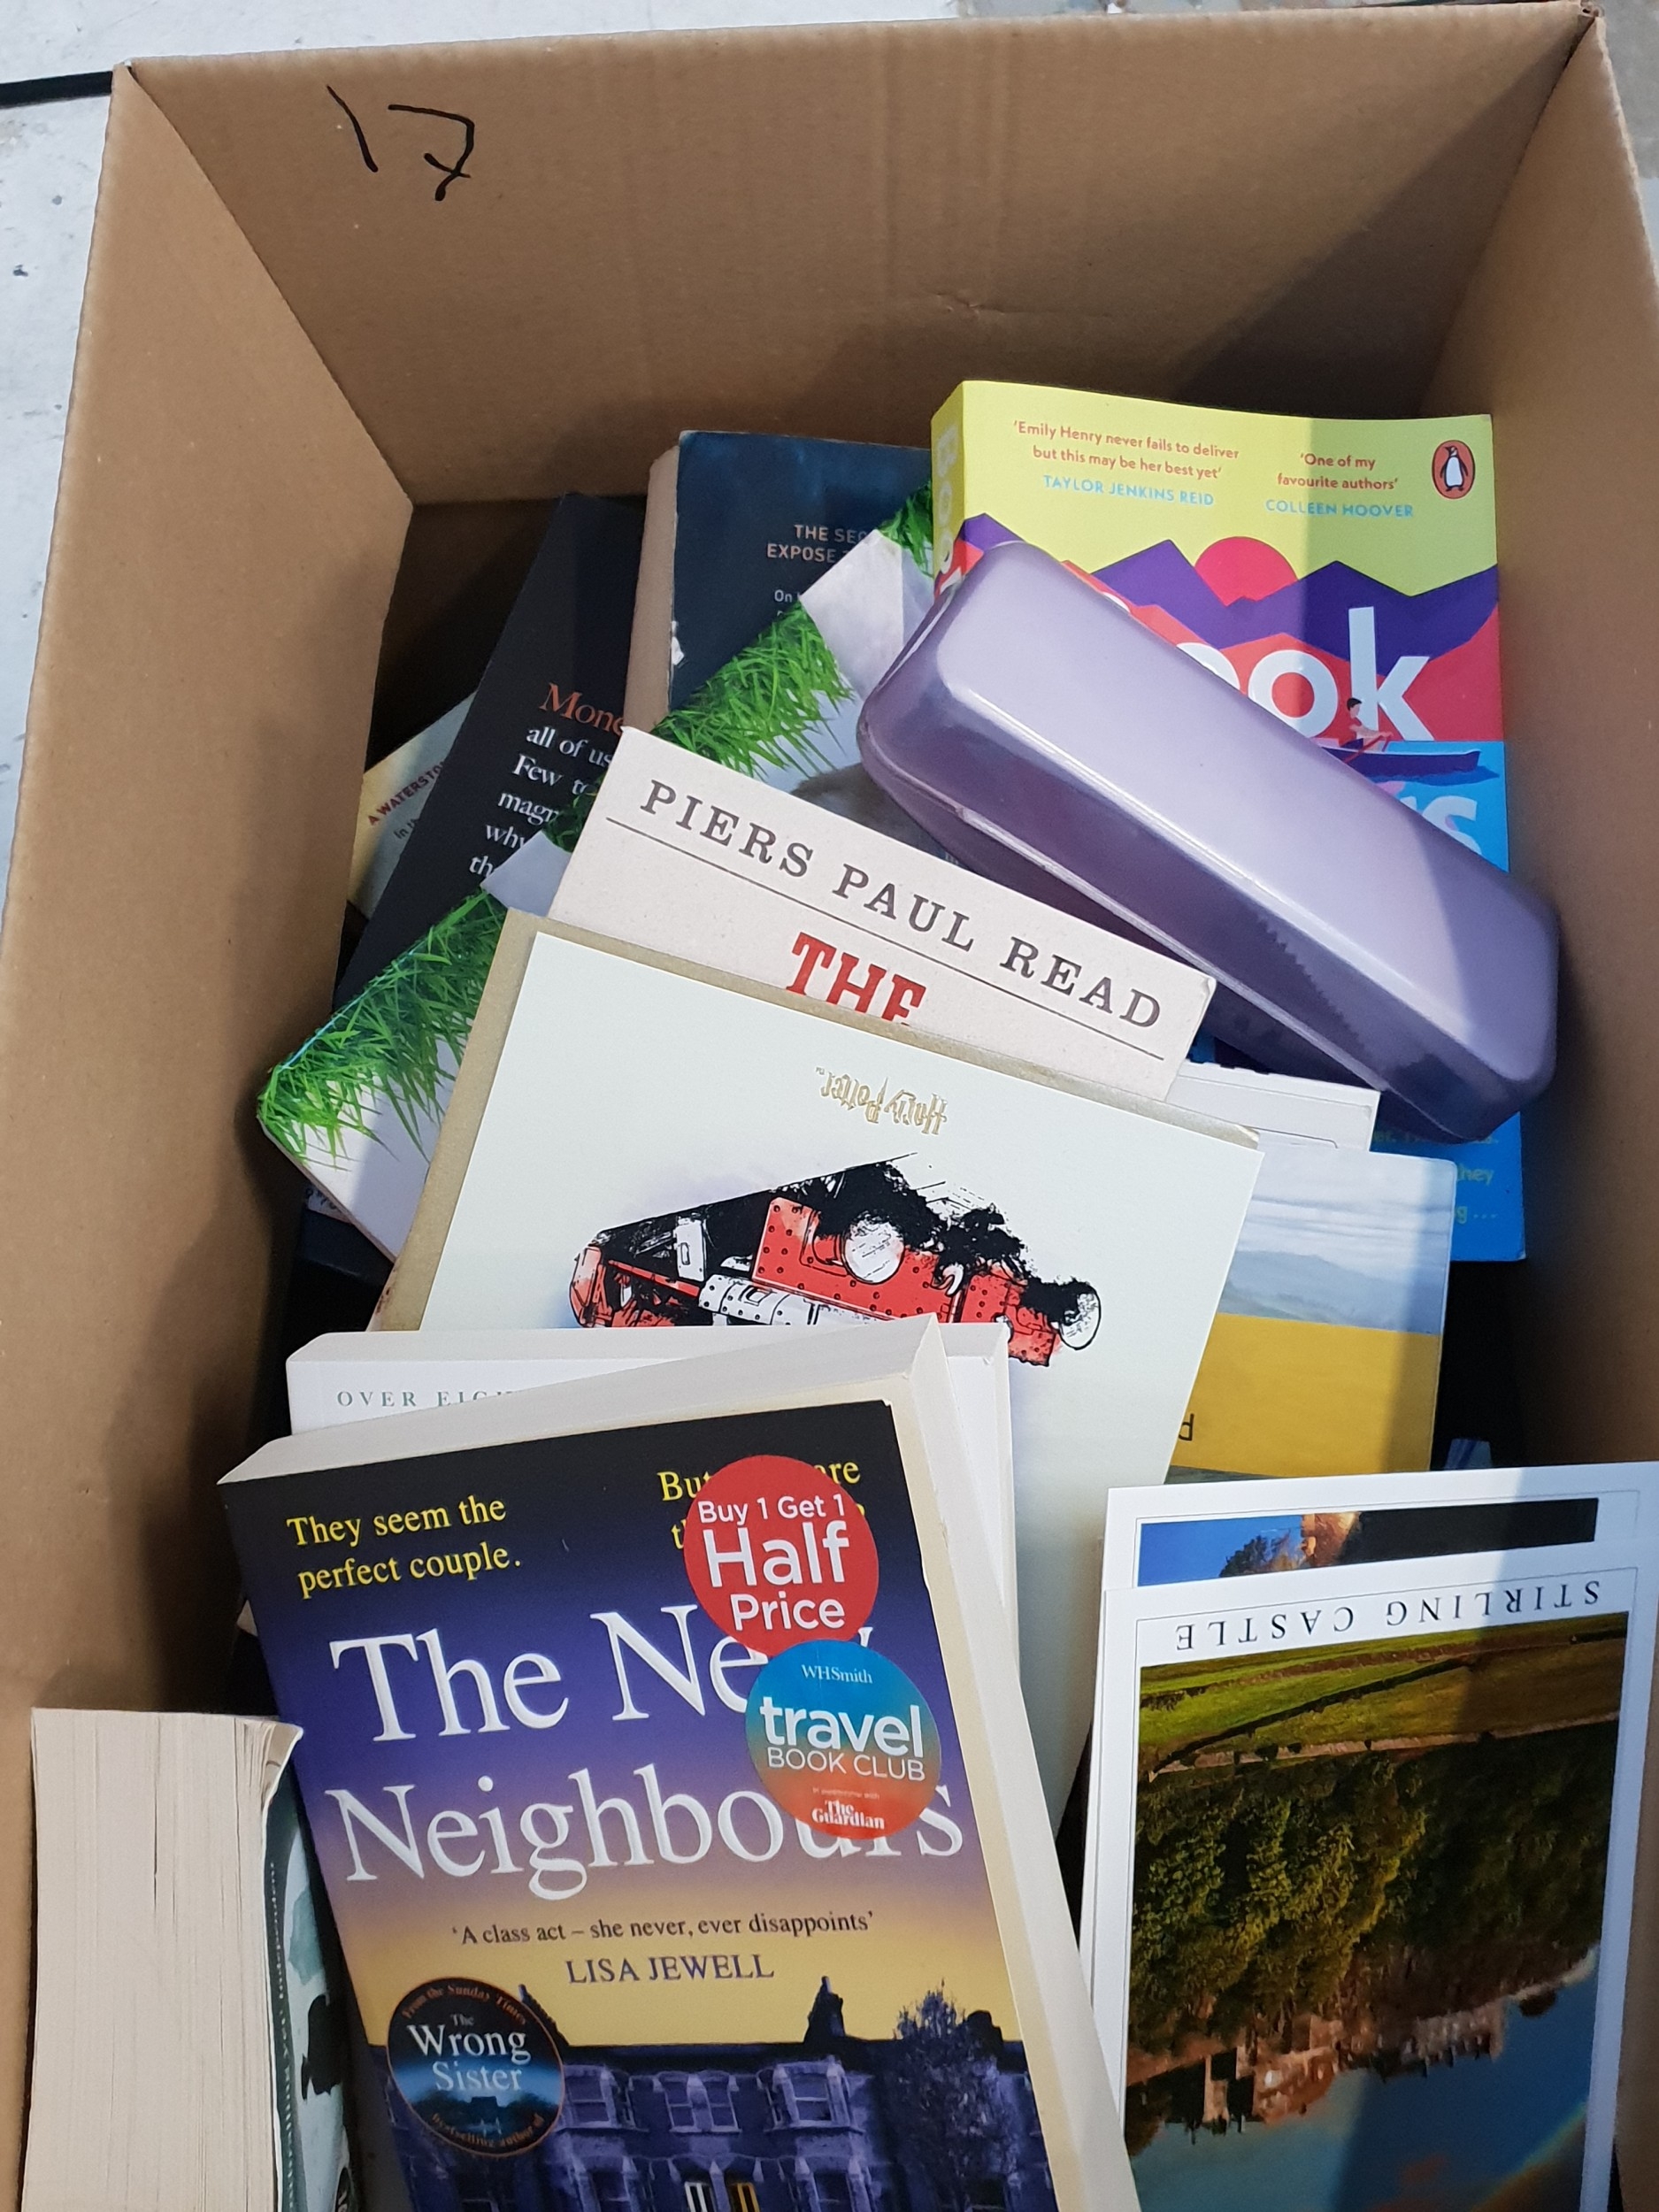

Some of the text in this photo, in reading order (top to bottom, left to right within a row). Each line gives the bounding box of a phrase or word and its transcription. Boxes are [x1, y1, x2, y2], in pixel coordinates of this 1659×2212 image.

[326, 84, 476, 202] 17
[1060, 426, 1102, 445] Henry
[1106, 434, 1143, 448] never
[1147, 436, 1172, 452] fails
[1176, 442, 1190, 454] to
[1193, 443, 1240, 459] deliver
[1033, 445, 1057, 460] but
[1060, 448, 1086, 464] this
[1089, 455, 1117, 470] may
[1119, 456, 1136, 469] be
[1140, 458, 1162, 472] her
[1164, 461, 1194, 477] best
[1337, 455, 1352, 467] of
[1355, 458, 1376, 471] my
[1043, 475, 1215, 506] TAYLOR JENKINS REID
[1277, 472, 1339, 488] favourite
[1266, 499, 1413, 518] COLLEEN HOOVER
[794, 524, 829, 541] THE
[767, 542, 836, 564] EXPOSE
[774, 589, 793, 603] On
[526, 726, 556, 749] all
[559, 739, 589, 758] of
[511, 753, 565, 787] Few
[367, 815, 380, 826] A
[640, 780, 1163, 1029] PIERS PAUL READ
[336, 1391, 417, 1407] OVER
[286, 1494, 507, 1548] They seem the
[697, 1500, 749, 1526] Buy
[757, 1496, 769, 1519] 1
[777, 1494, 826, 1519] Get
[833, 1493, 846, 1517] 1
[703, 1519, 850, 1588] Half
[297, 1540, 522, 1600] perfect couple.
[730, 1590, 846, 1632] Price
[1176, 1580, 1601, 1651] STIRLING CASTLE
[329, 1604, 873, 1742] The Ne
[802, 1664, 873, 1684] WHSmith
[759, 1696, 924, 1758] travel
[767, 1747, 926, 1781] BOOK CLUB
[811, 1808, 885, 1830] Guardian
[824, 1799, 855, 1816] The
[324, 1763, 964, 1900] Neighbos
[481, 1924, 531, 1944] class
[536, 1923, 567, 1941] act
[590, 1918, 625, 1939] she
[630, 1917, 694, 1939] never,
[697, 1917, 742, 1935] ever
[565, 1953, 775, 1985] LISA JEWELL
[447, 1985, 491, 2002] Sunday
[495, 1993, 527, 2025] Times
[449, 2013, 475, 2027] The
[406, 2024, 532, 2065] Wrong
[432, 2060, 523, 2092] Sister
